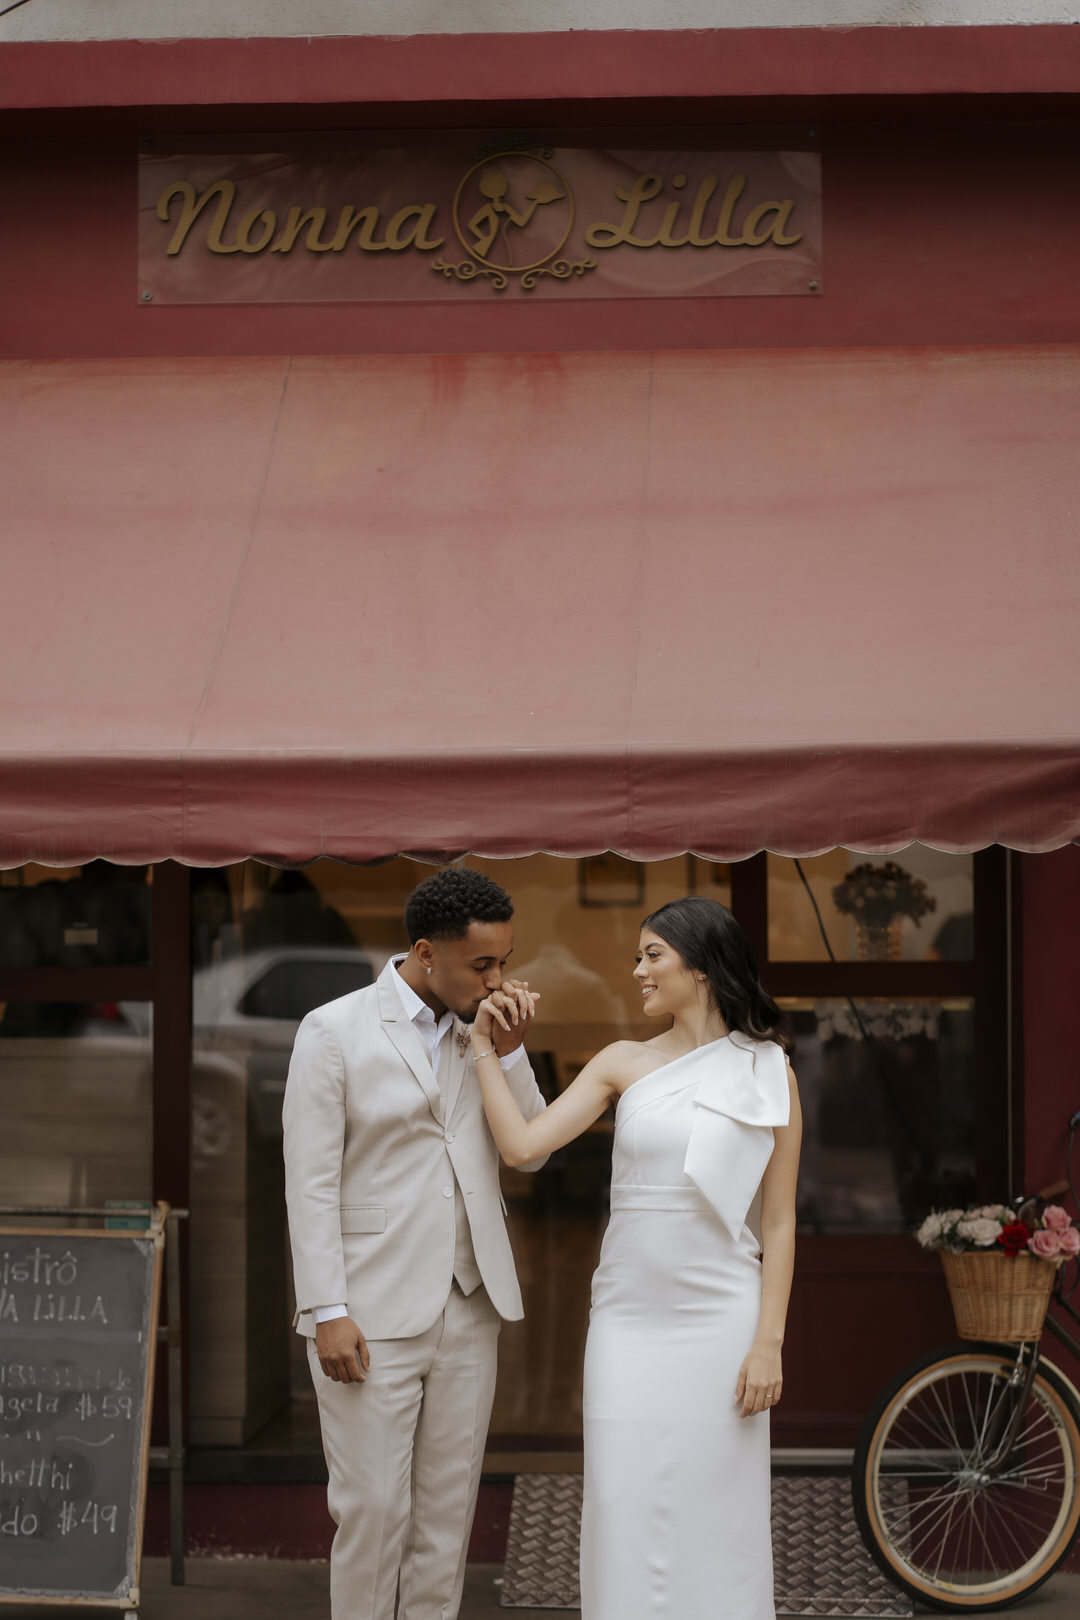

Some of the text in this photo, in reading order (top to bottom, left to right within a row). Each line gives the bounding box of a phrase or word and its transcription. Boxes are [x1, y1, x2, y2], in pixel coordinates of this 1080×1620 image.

[157, 173, 802, 255] Nonna Lilla
[0, 1247, 78, 1286] istrô
[74, 1392, 133, 1421] $59
[56, 1500, 118, 1536] $49
